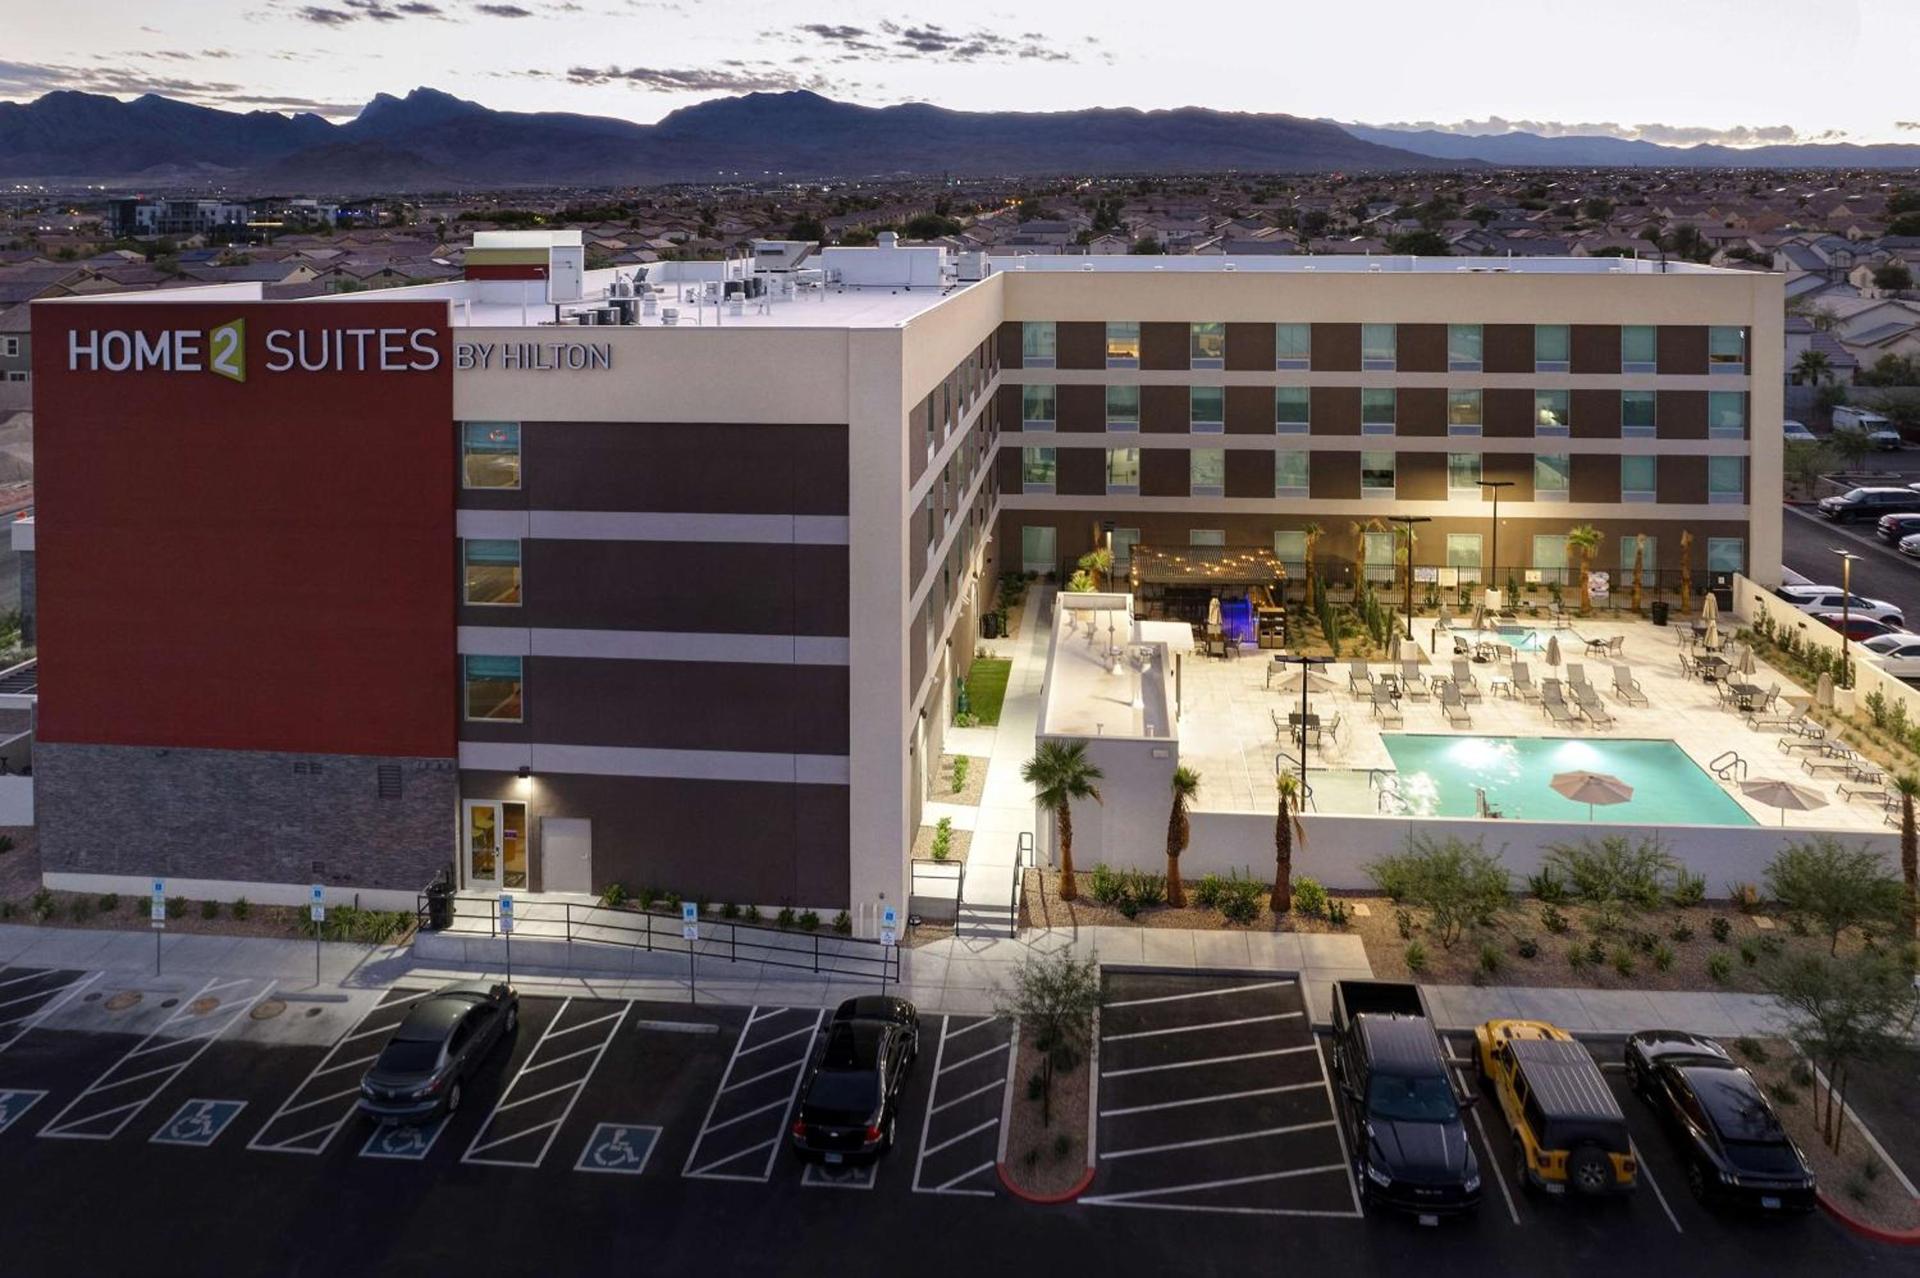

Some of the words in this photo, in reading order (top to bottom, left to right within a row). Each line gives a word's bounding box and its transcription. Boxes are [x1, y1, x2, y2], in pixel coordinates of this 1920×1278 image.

[69, 329, 201, 371] HOME
[214, 327, 240, 376] 2
[265, 328, 440, 371] SUITES
[456, 343, 495, 369] BY
[502, 343, 611, 370] HILTON
